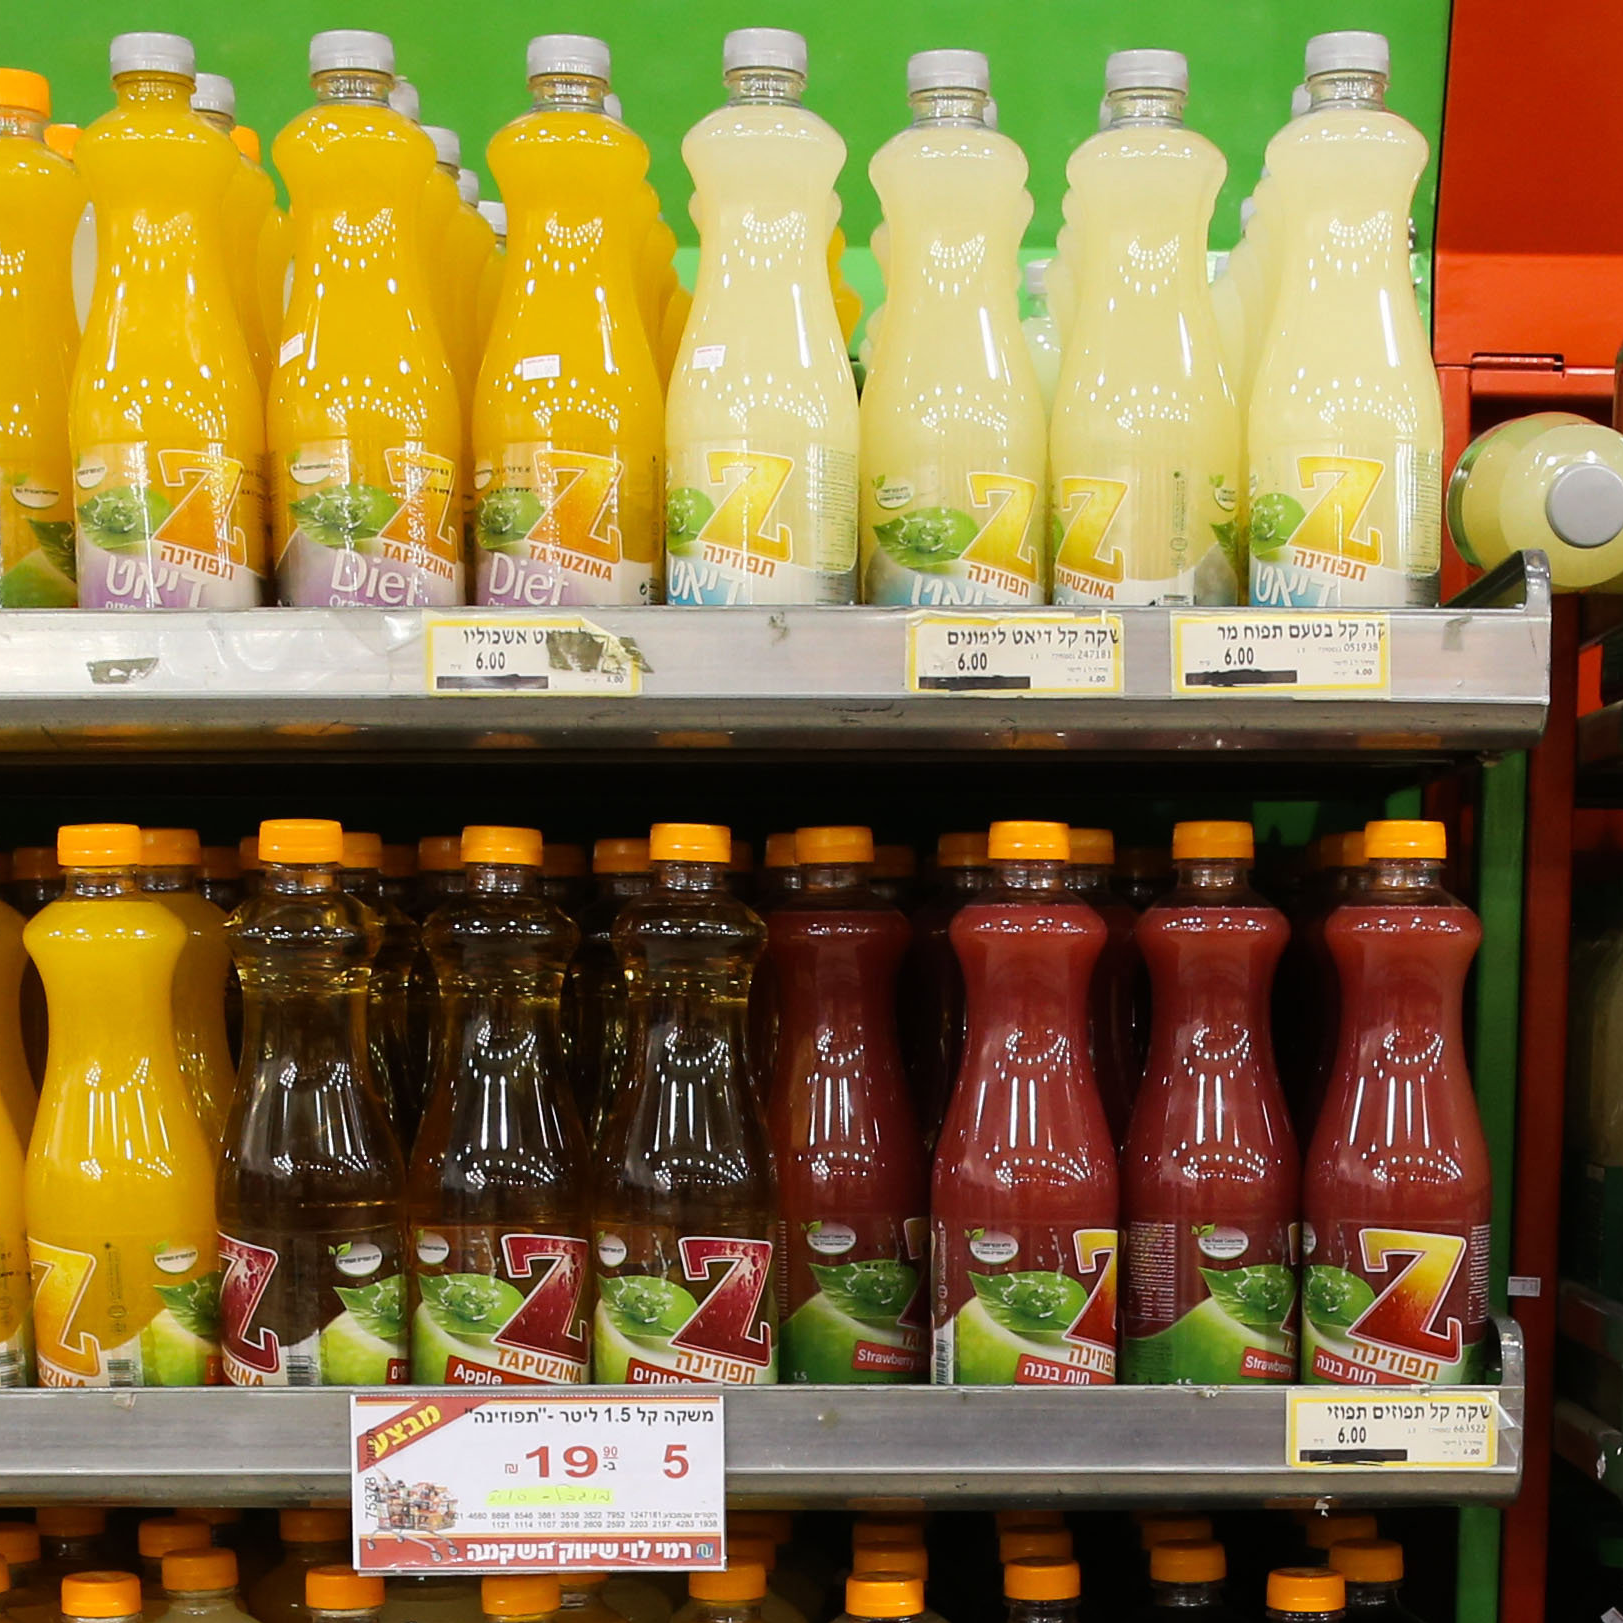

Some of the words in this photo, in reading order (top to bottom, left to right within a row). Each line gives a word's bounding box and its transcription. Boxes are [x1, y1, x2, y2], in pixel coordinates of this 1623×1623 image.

[528, 545, 613, 582] TAPUZINA
[489, 551, 570, 604] Diet
[948, 627, 1005, 646] לימונים
[1013, 629, 1051, 644] דיאט
[1218, 626, 1237, 640] מר
[1245, 624, 1283, 640] תפוח
[1289, 625, 1332, 639] בטעם
[476, 651, 505, 670] 6.00
[958, 653, 987, 671] 6.00
[1225, 647, 1254, 665] 6.00
[1352, 1341, 1440, 1382] תפוזינה
[454, 1364, 503, 1384] Apple
[561, 1408, 599, 1424] ליטר
[605, 1408, 630, 1424] 1.5
[637, 1407, 658, 1426] קל
[664, 1409, 714, 1427] משקה
[1327, 1406, 1367, 1420] תפוזי
[1373, 1406, 1425, 1420] תפוזים
[1430, 1403, 1450, 1421] קל
[368, 1404, 442, 1459] מבצע
[1338, 1427, 1366, 1444] 6.00
[603, 1446, 618, 1458] 90
[527, 1445, 599, 1478] 19
[664, 1444, 690, 1479] 5
[467, 1542, 555, 1565] השקמה
[560, 1542, 619, 1565] שיווק
[627, 1541, 654, 1560] לוי
[656, 1542, 692, 1560] רמי
